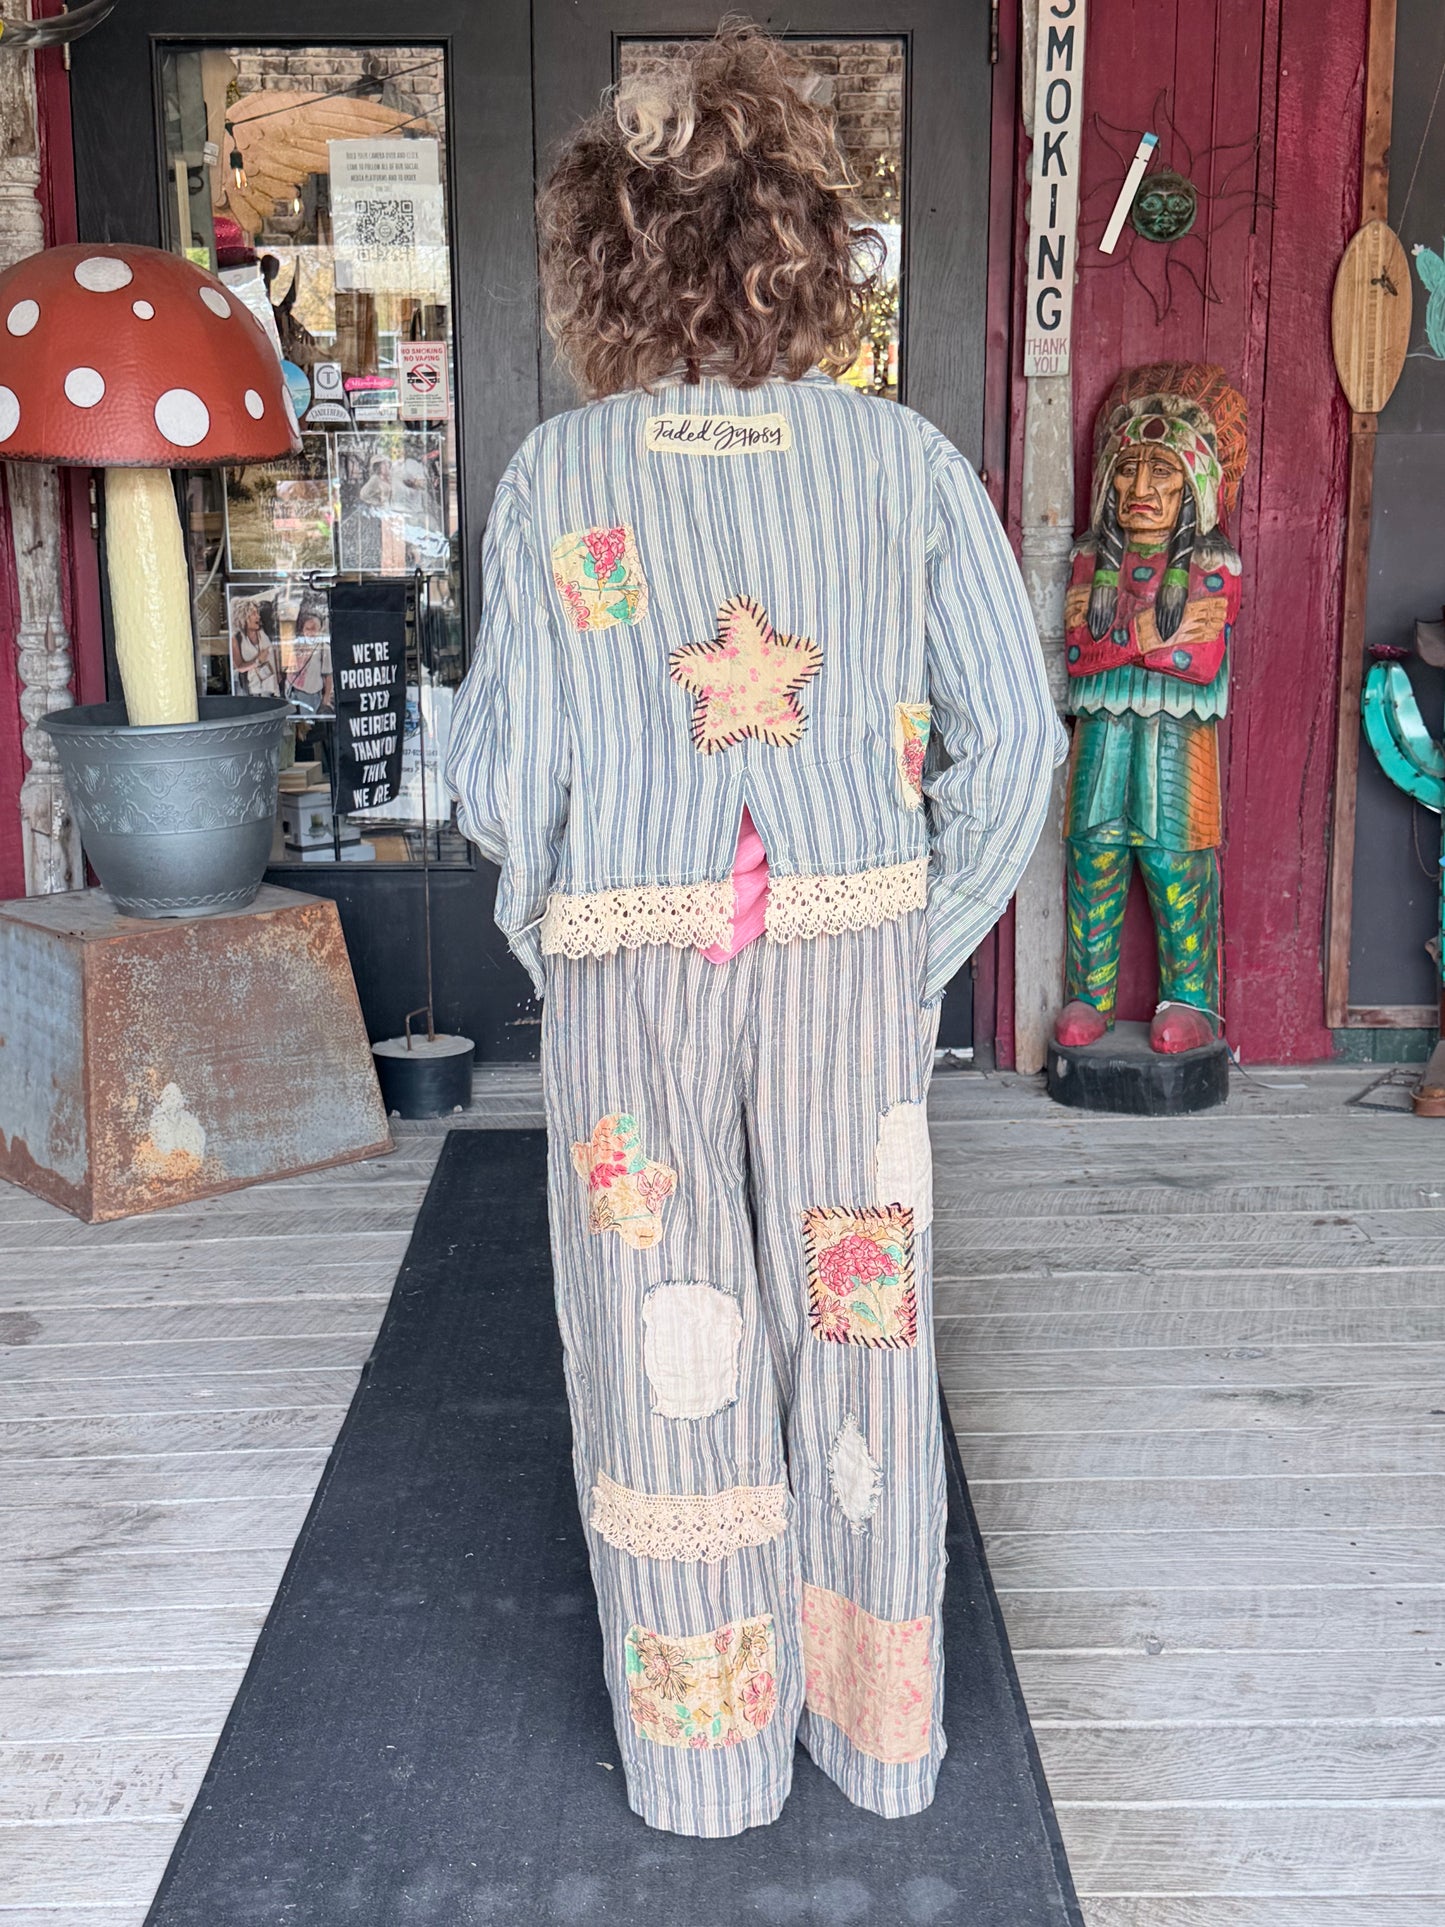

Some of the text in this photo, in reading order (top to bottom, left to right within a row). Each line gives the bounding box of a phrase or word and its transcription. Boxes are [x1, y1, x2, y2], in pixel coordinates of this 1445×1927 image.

[412, 347, 443, 355] SMOKING
[1026, 338, 1068, 356] THANK
[1033, 356, 1059, 374] YOU
[713, 420, 783, 451] Gypsy
[352, 641, 390, 664] WE'RE
[353, 787, 370, 809] WE
